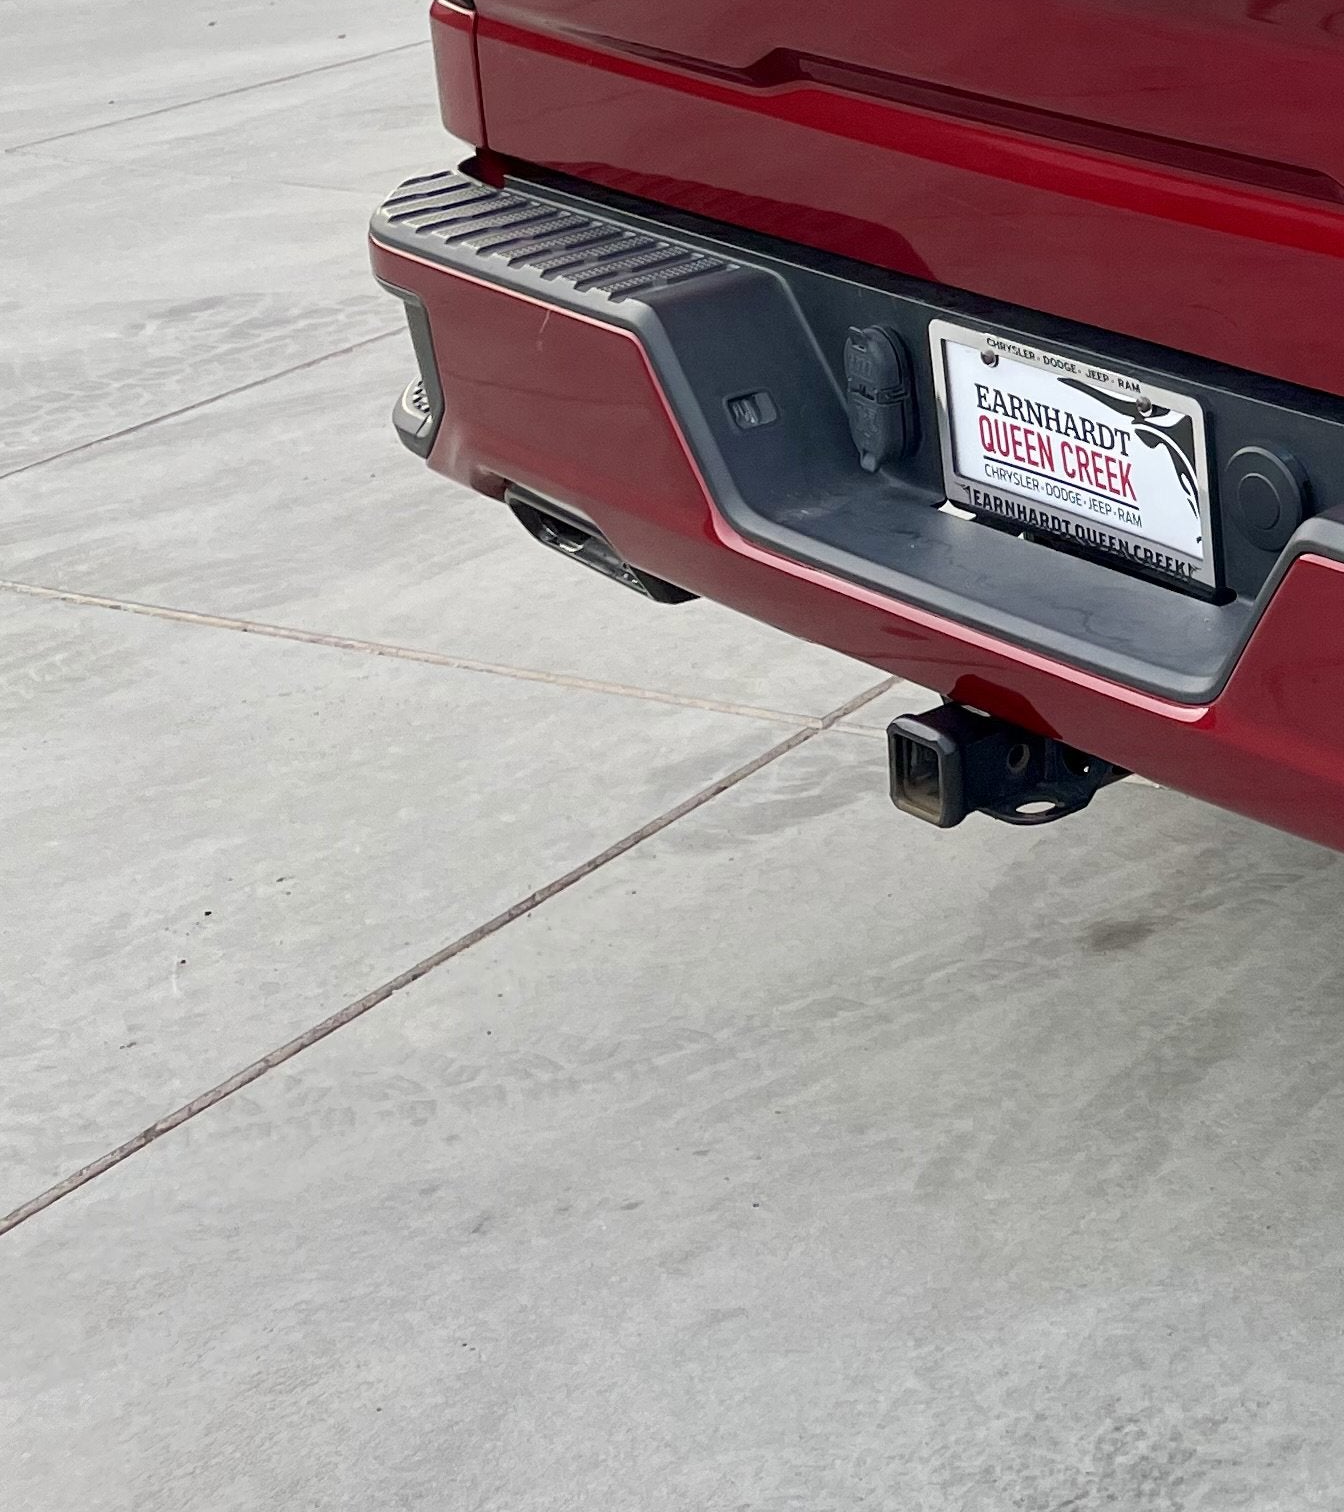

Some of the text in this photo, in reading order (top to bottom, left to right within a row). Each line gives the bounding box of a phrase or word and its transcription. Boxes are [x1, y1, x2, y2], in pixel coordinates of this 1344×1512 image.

[986, 337, 1142, 395] CHRYSLER DODGE JEEP RAM
[974, 382, 1131, 457] EARNHARDT
[978, 414, 1138, 502] QUEEN CREEK
[973, 488, 1072, 537] EARNHARDT
[1074, 523, 1130, 560] QUEEN
[984, 463, 1143, 529] CHRYSLER DODGE JEEP RAM
